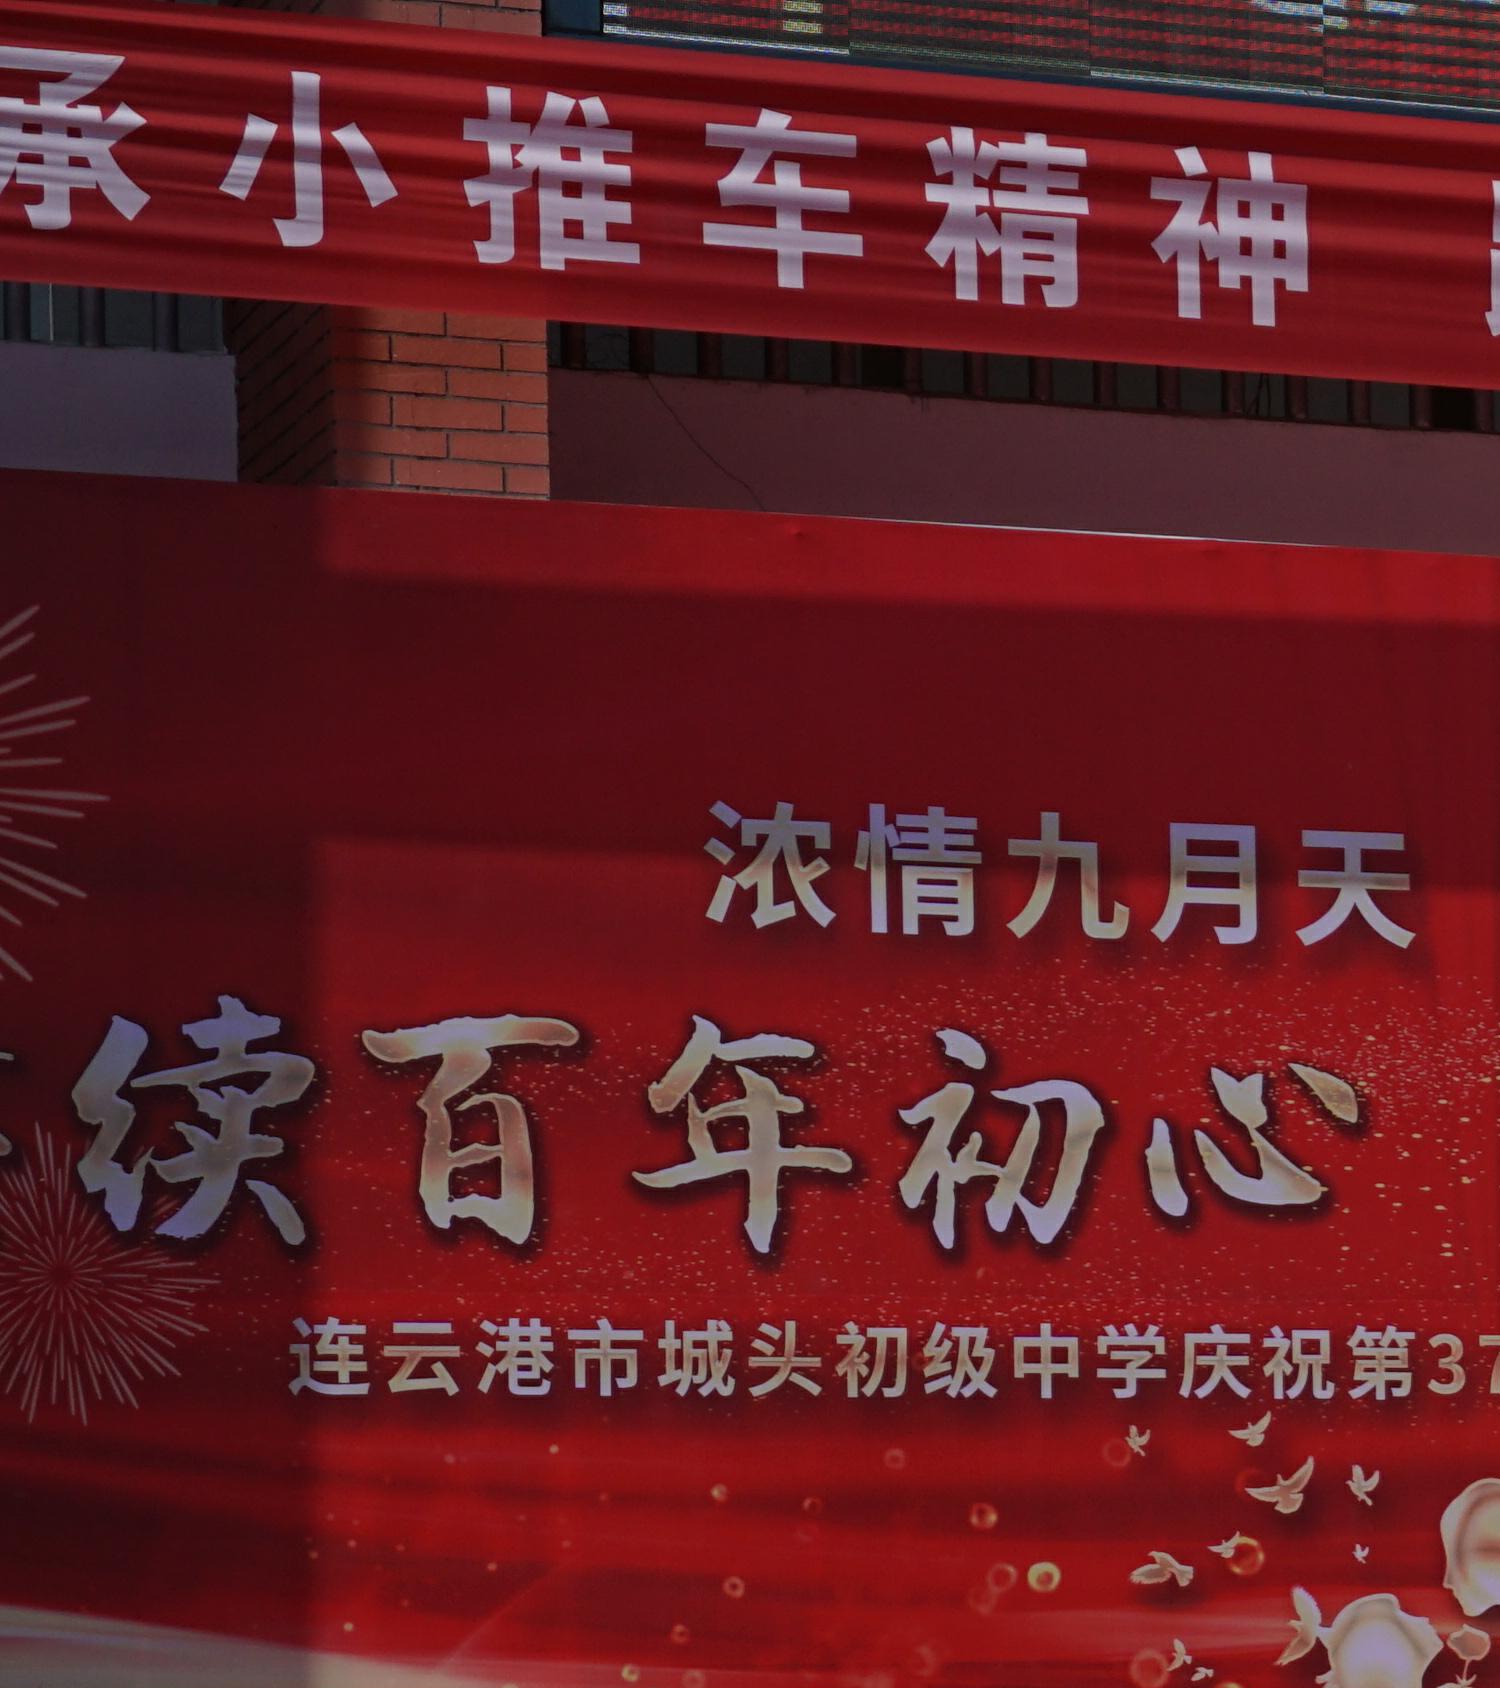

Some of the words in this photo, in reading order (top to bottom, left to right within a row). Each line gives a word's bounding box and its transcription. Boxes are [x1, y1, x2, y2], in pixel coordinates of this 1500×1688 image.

[0, 45, 1311, 328] 承小推车精神
[705, 803, 1417, 949] 浓情九月天
[0, 995, 1361, 1254] 续百年初心
